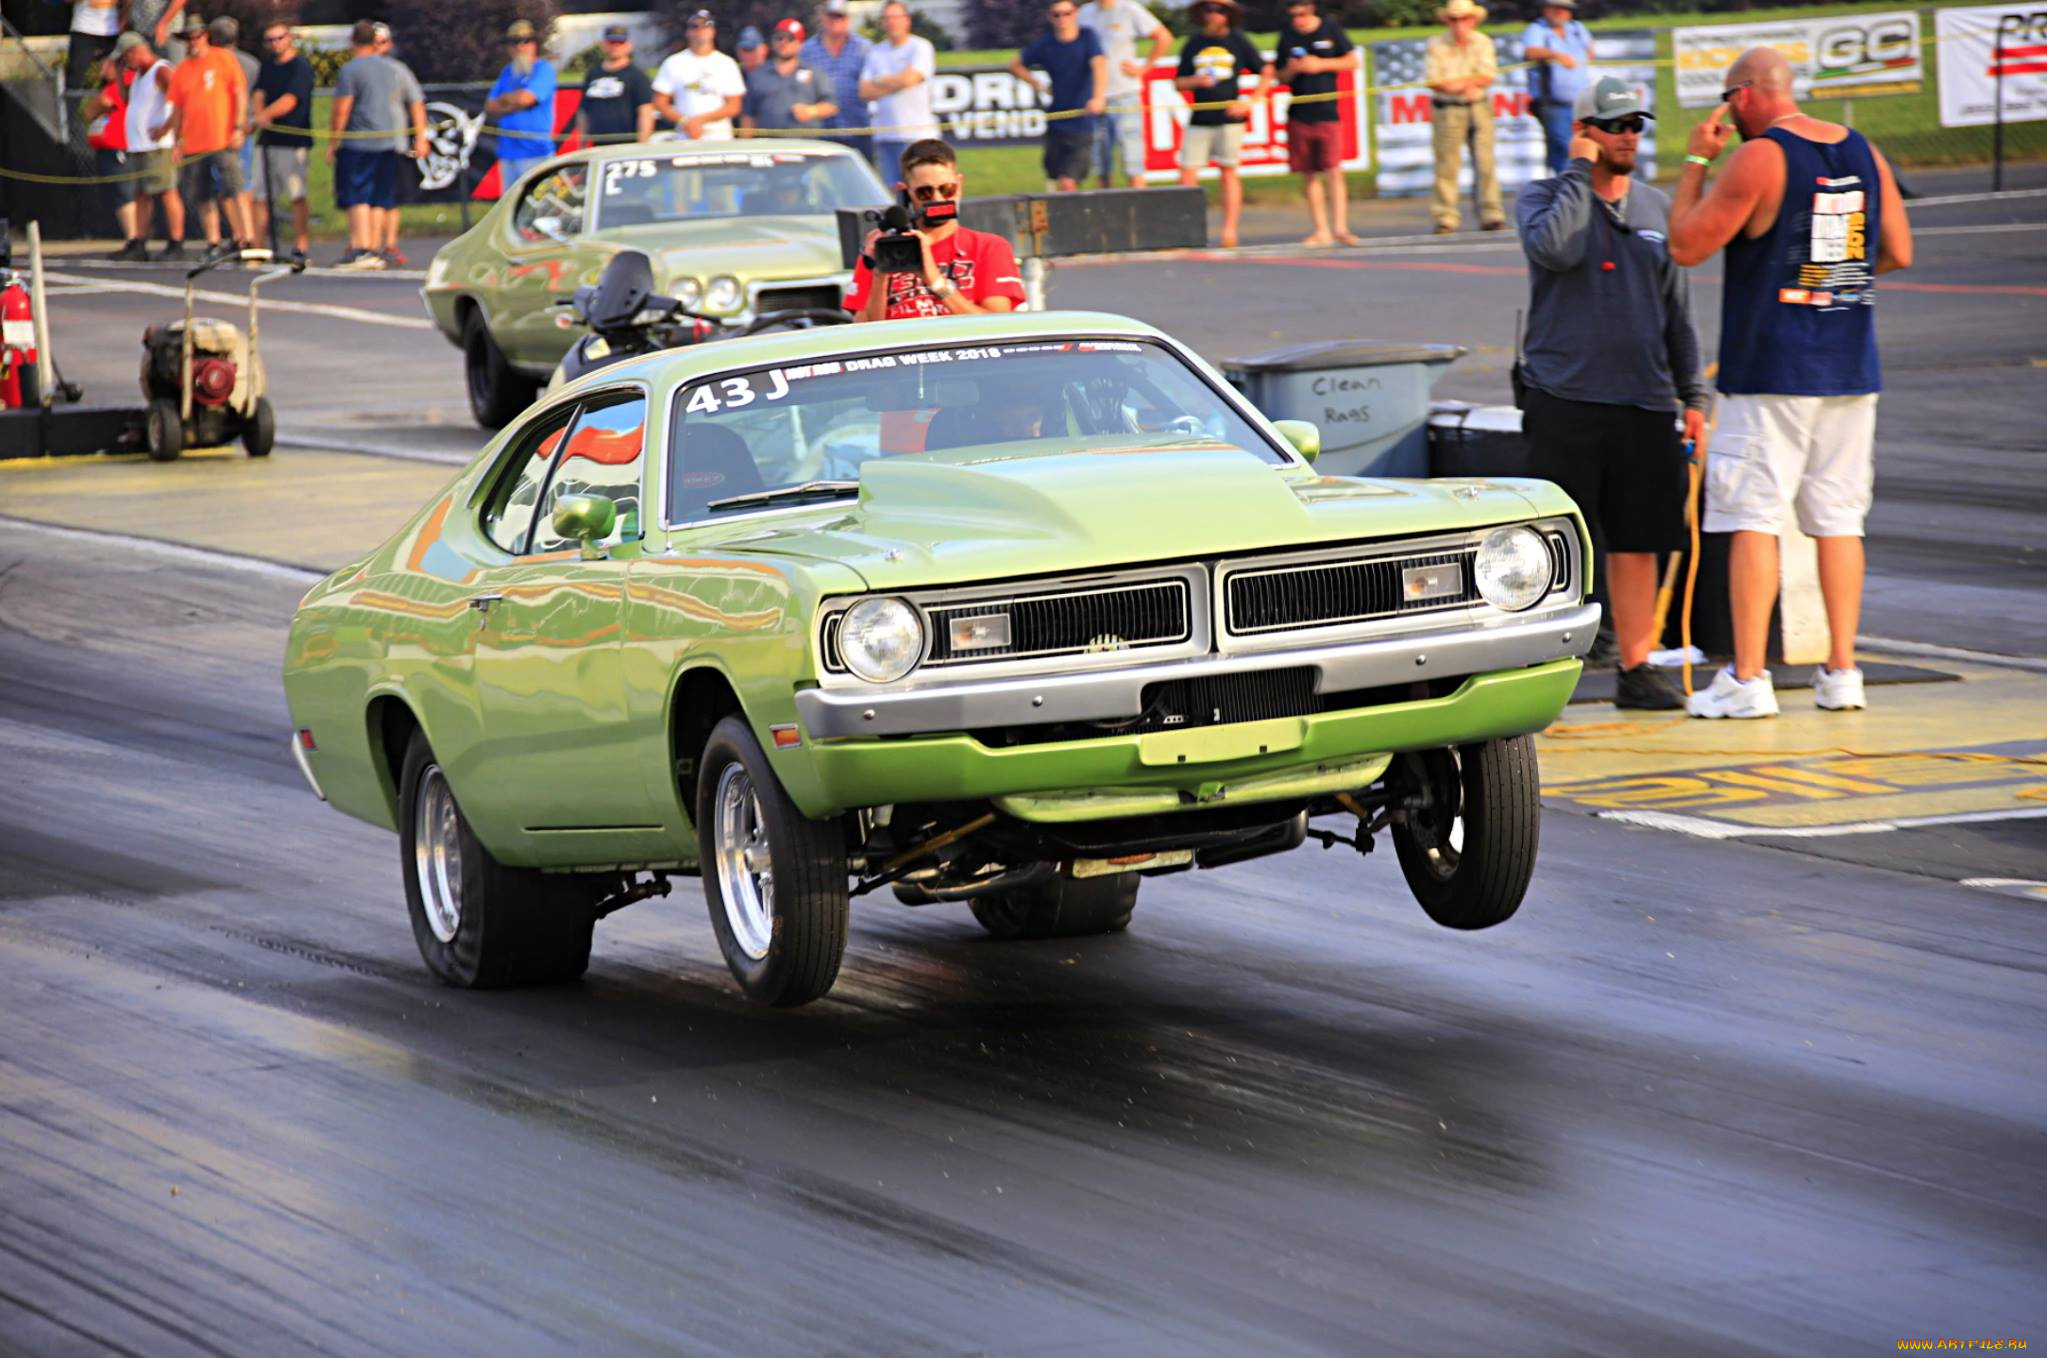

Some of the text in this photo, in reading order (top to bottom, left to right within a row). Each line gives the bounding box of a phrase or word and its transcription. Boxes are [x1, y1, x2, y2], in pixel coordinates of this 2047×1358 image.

[1818, 19, 1913, 70] GC
[606, 160, 658, 179] 275
[683, 377, 755, 415] 43
[766, 368, 790, 401] J
[845, 354, 897, 372] DRAG
[898, 350, 954, 366] WEEK
[955, 347, 1002, 361] 2018
[1312, 377, 1382, 396] Clean
